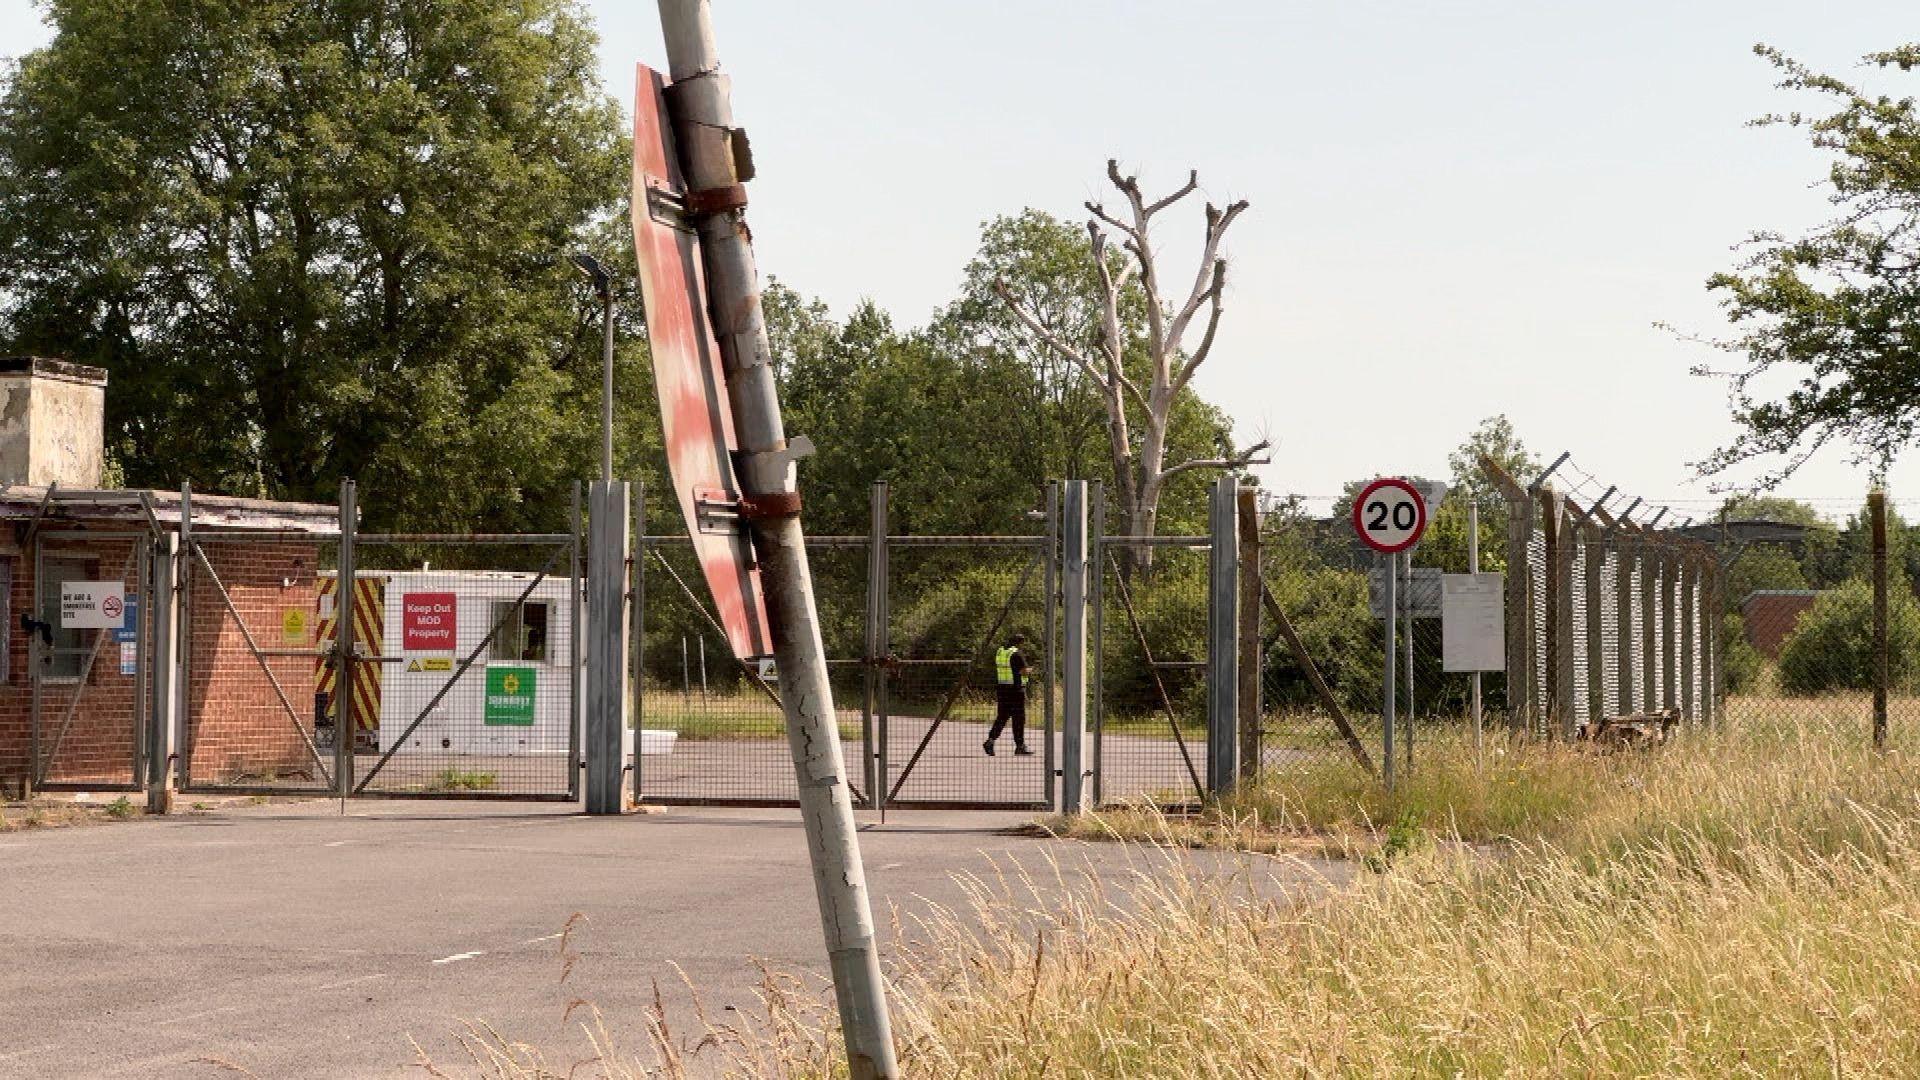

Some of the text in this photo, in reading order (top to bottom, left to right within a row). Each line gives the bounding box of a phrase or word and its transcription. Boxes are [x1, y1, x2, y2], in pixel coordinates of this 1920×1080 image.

[1367, 501, 1416, 530] 20
[407, 603, 451, 614] Keep Out
[417, 616, 441, 625] MOD
[408, 628, 450, 639] Property
